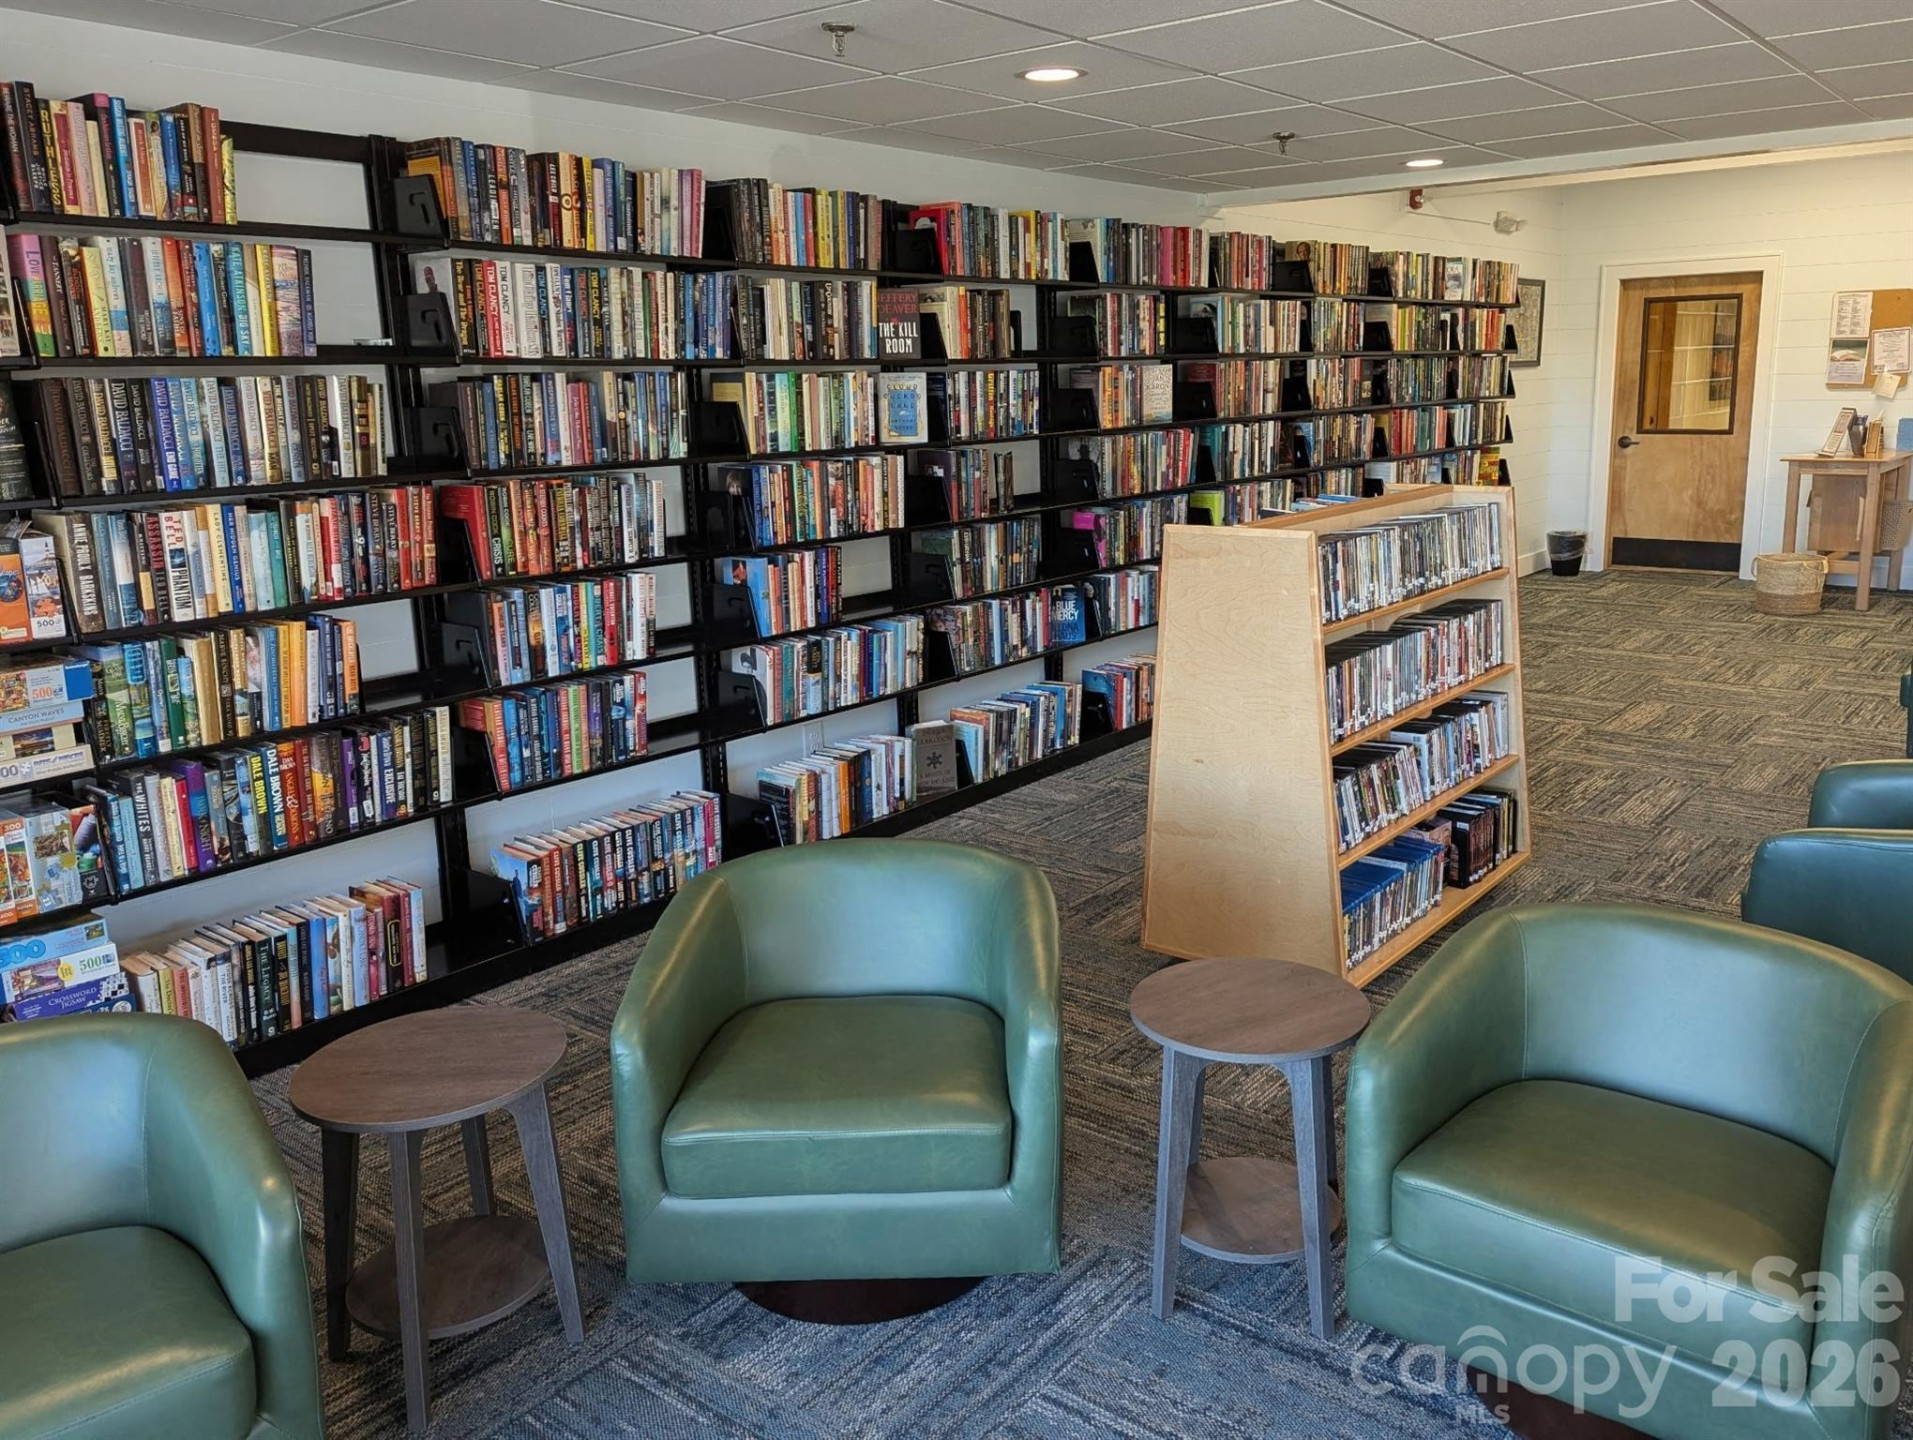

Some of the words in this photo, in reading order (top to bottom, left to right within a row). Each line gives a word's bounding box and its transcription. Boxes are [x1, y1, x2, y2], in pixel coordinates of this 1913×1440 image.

[24, 88, 34, 119] STACEY
[29, 122, 39, 156] ABRAMS
[210, 122, 218, 151] OMEGA
[41, 110, 61, 205] RUTHLESS
[549, 164, 557, 175] LEE
[550, 176, 559, 193] CHILD
[26, 251, 40, 275] LOVE
[231, 247, 241, 266] KATE
[233, 269, 245, 311] ATKINSON
[476, 281, 485, 314] CLANCY
[489, 284, 498, 317] CLANCY
[501, 284, 510, 315] CLANCY
[539, 288, 547, 319] CLANCY
[580, 288, 588, 319] CLANCY
[240, 330, 248, 344] SKY
[879, 322, 895, 337] THE
[899, 322, 918, 337] KILL
[885, 338, 912, 353] ROOM
[111, 382, 126, 409] DAVID
[131, 385, 141, 406] DAVID
[155, 381, 168, 407] DAVID
[206, 380, 218, 406] DAVID
[317, 379, 326, 400] DAVID
[134, 408, 146, 440] BALDACCI
[158, 409, 172, 450] BALDACCI
[208, 408, 222, 442] BALDACCI
[318, 401, 329, 432] BALDACCI
[116, 411, 132, 451] BALDACCI
[166, 452, 176, 463] END
[168, 464, 178, 480] GAME
[489, 490, 498, 512] ROBIN
[72, 523, 89, 544] ANNIE
[164, 516, 176, 548] BELL
[173, 519, 183, 542] TED
[213, 512, 224, 536] LADY
[491, 514, 499, 535] COOK
[146, 516, 162, 569] ASSASSIN
[229, 527, 237, 555] HIDDEN
[492, 537, 504, 564] CRISIS
[506, 538, 516, 564] CURE
[216, 537, 228, 582] CLEMENTINE
[231, 556, 240, 581] GENIUS
[156, 572, 166, 588] TED
[171, 569, 192, 610] PHANTOM
[80, 575, 97, 615] BARKSKINS
[158, 590, 168, 612] BELL
[1056, 601, 1076, 610] BLUE
[32, 686, 52, 699] 500
[9, 712, 40, 724] CANYON
[250, 756, 262, 779] DALE
[267, 749, 279, 778] DALE
[253, 781, 267, 814] BROWN
[270, 779, 283, 812] BROWN
[384, 768, 395, 804] EXCLUSIVE
[134, 794, 152, 832] WHITES
[674, 813, 682, 828] CLIVE
[625, 829, 633, 845] CLIVE
[576, 843, 584, 861] CLIVE
[627, 846, 635, 872] CUSSLER
[554, 868, 562, 891] CUSSLER
[578, 862, 586, 889] CUSSLER
[80, 956, 101, 971] 500
[260, 944, 270, 967] THE
[48, 987, 97, 1006] CROSSWORD
[262, 970, 272, 1002] LEGACY
